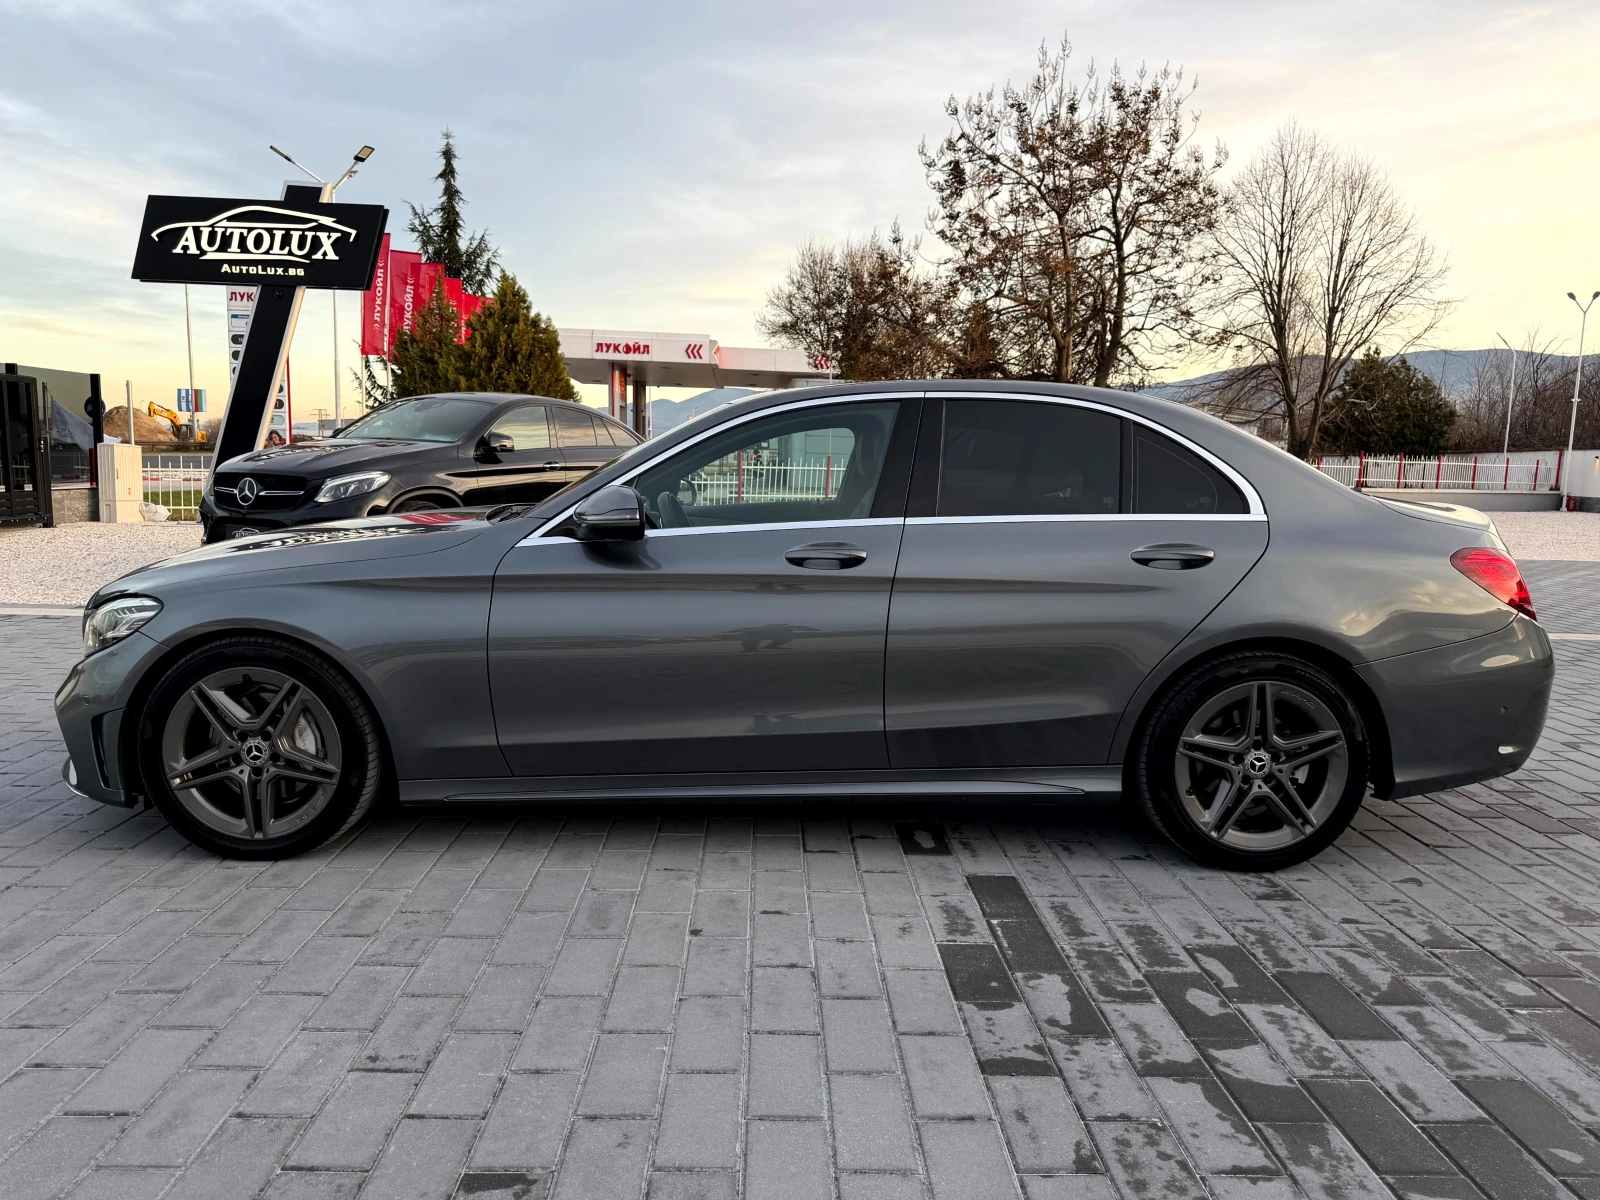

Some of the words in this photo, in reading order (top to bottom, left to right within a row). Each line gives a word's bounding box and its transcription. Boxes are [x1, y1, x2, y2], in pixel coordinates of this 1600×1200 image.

[172, 226, 341, 260] AUTOLUX
[229, 291, 255, 302] ЛУК
[374, 268, 384, 322] ЛУКОЙЛ
[595, 341, 650, 355] ЛУКОЙЛ
